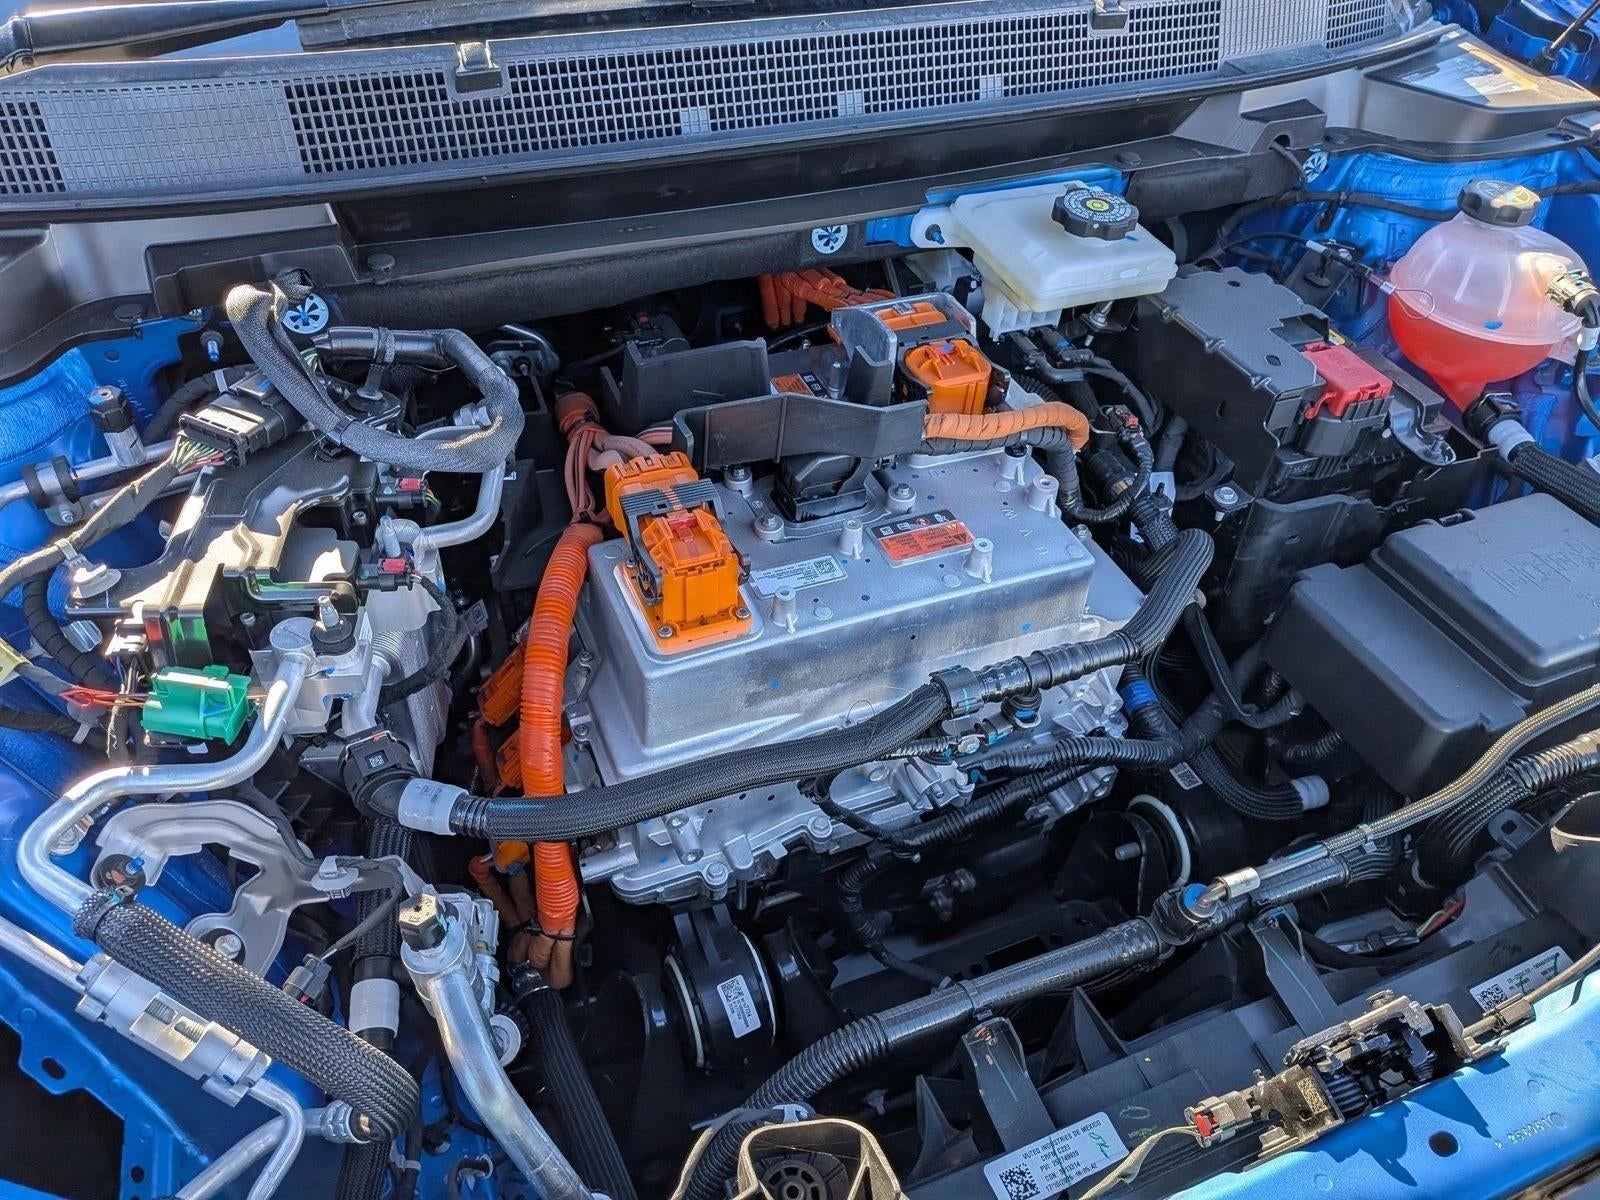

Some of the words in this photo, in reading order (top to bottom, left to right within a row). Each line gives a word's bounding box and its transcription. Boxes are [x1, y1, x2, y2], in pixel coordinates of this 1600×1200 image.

[1041, 1133, 1072, 1150] INDUSTRIES
[1072, 1129, 1081, 1138] DE
[1081, 1120, 1101, 1132] MEXICO
